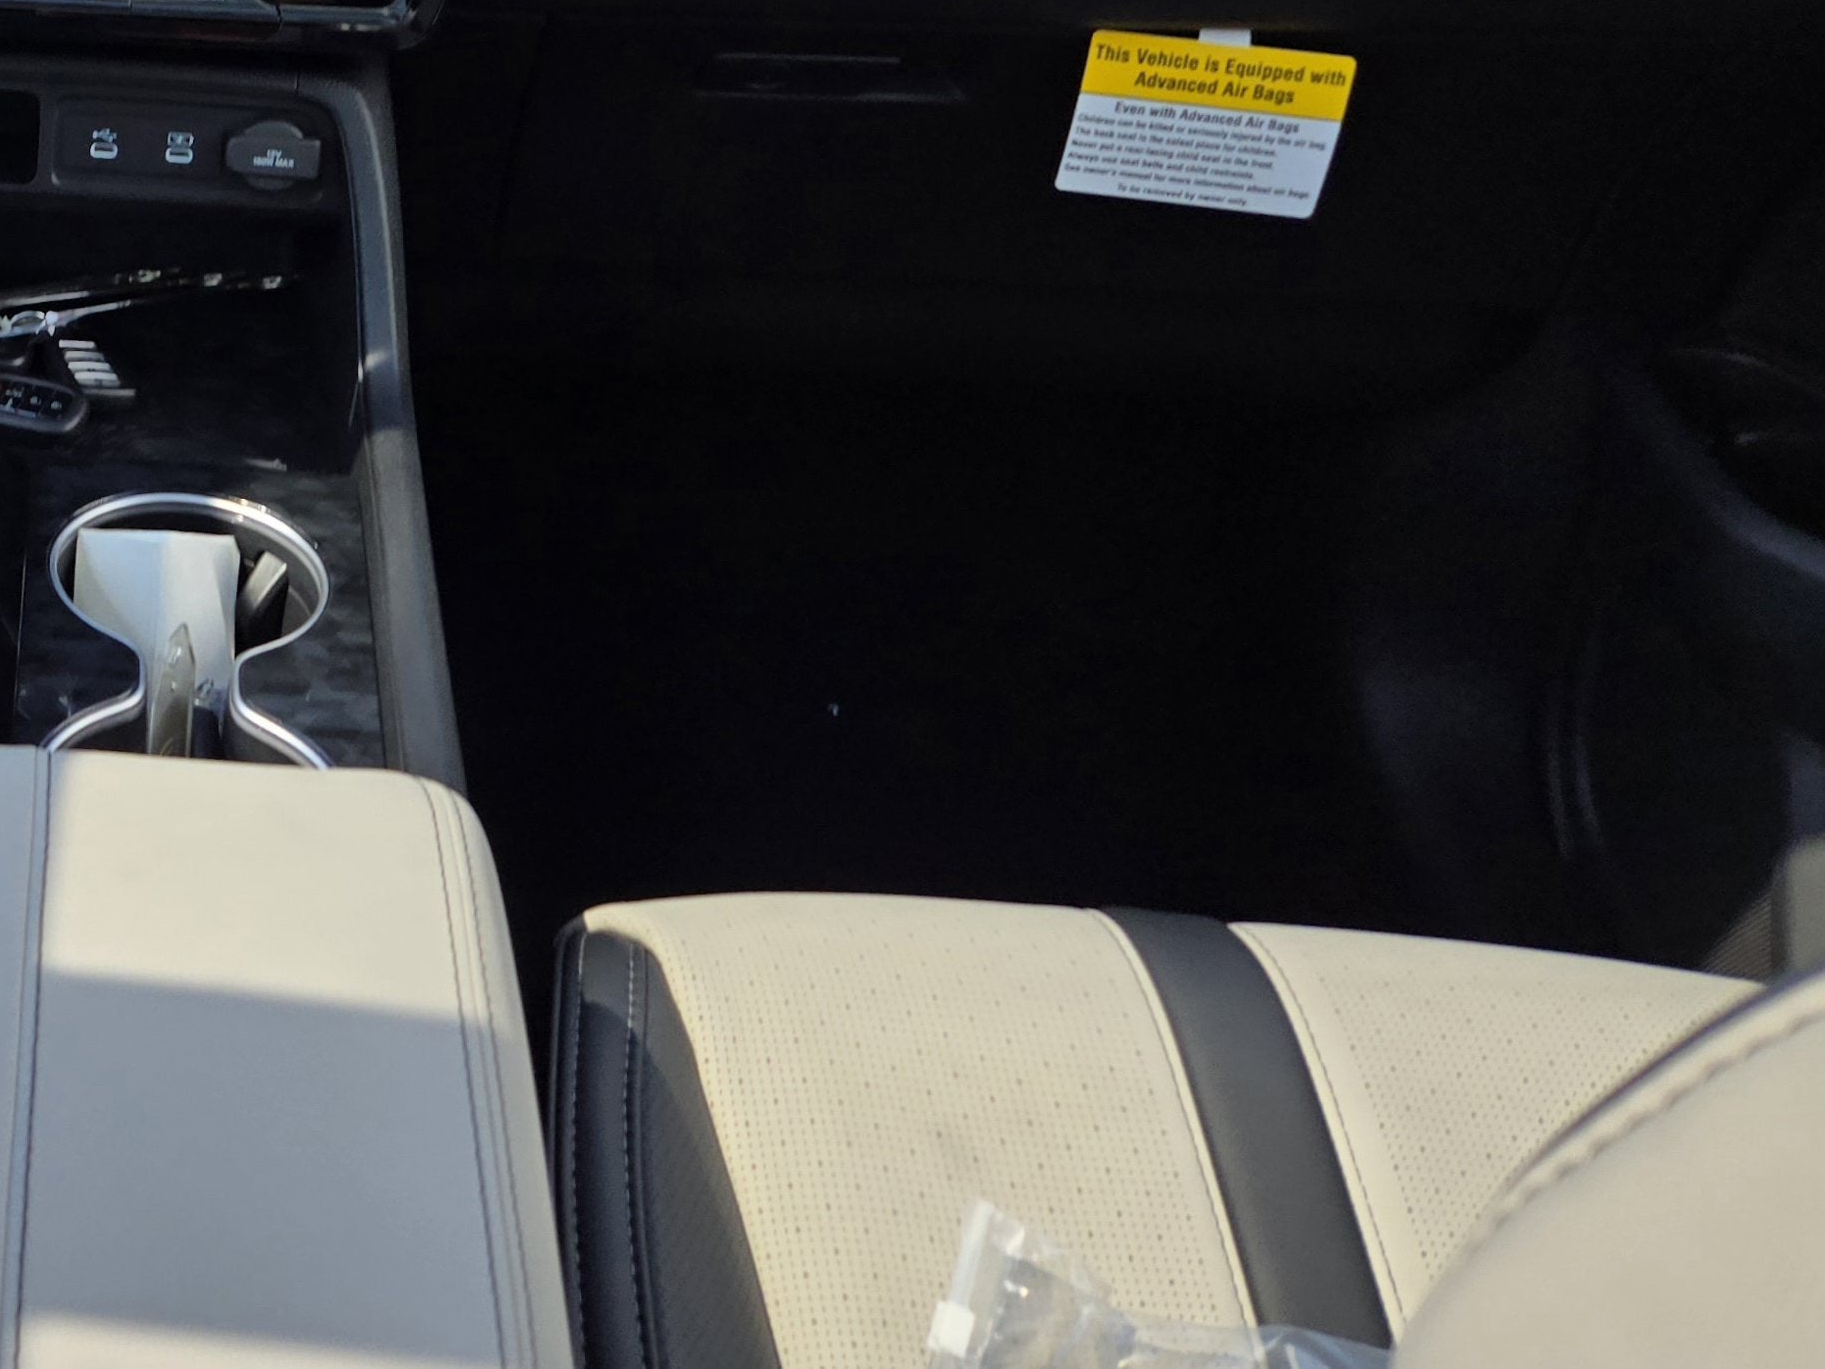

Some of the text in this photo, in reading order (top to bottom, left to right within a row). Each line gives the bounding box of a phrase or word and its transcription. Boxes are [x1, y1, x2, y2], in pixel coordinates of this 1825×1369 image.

[1096, 42, 1346, 86] This Vehicle is Equipped with
[1134, 71, 1295, 106] Advanced Air Bags
[1115, 101, 1300, 136] Even with Advanced Air Bags
[1135, 119, 1146, 128] be
[1149, 120, 1174, 132] killed
[1176, 125, 1185, 133] or
[1149, 134, 1163, 143] the
